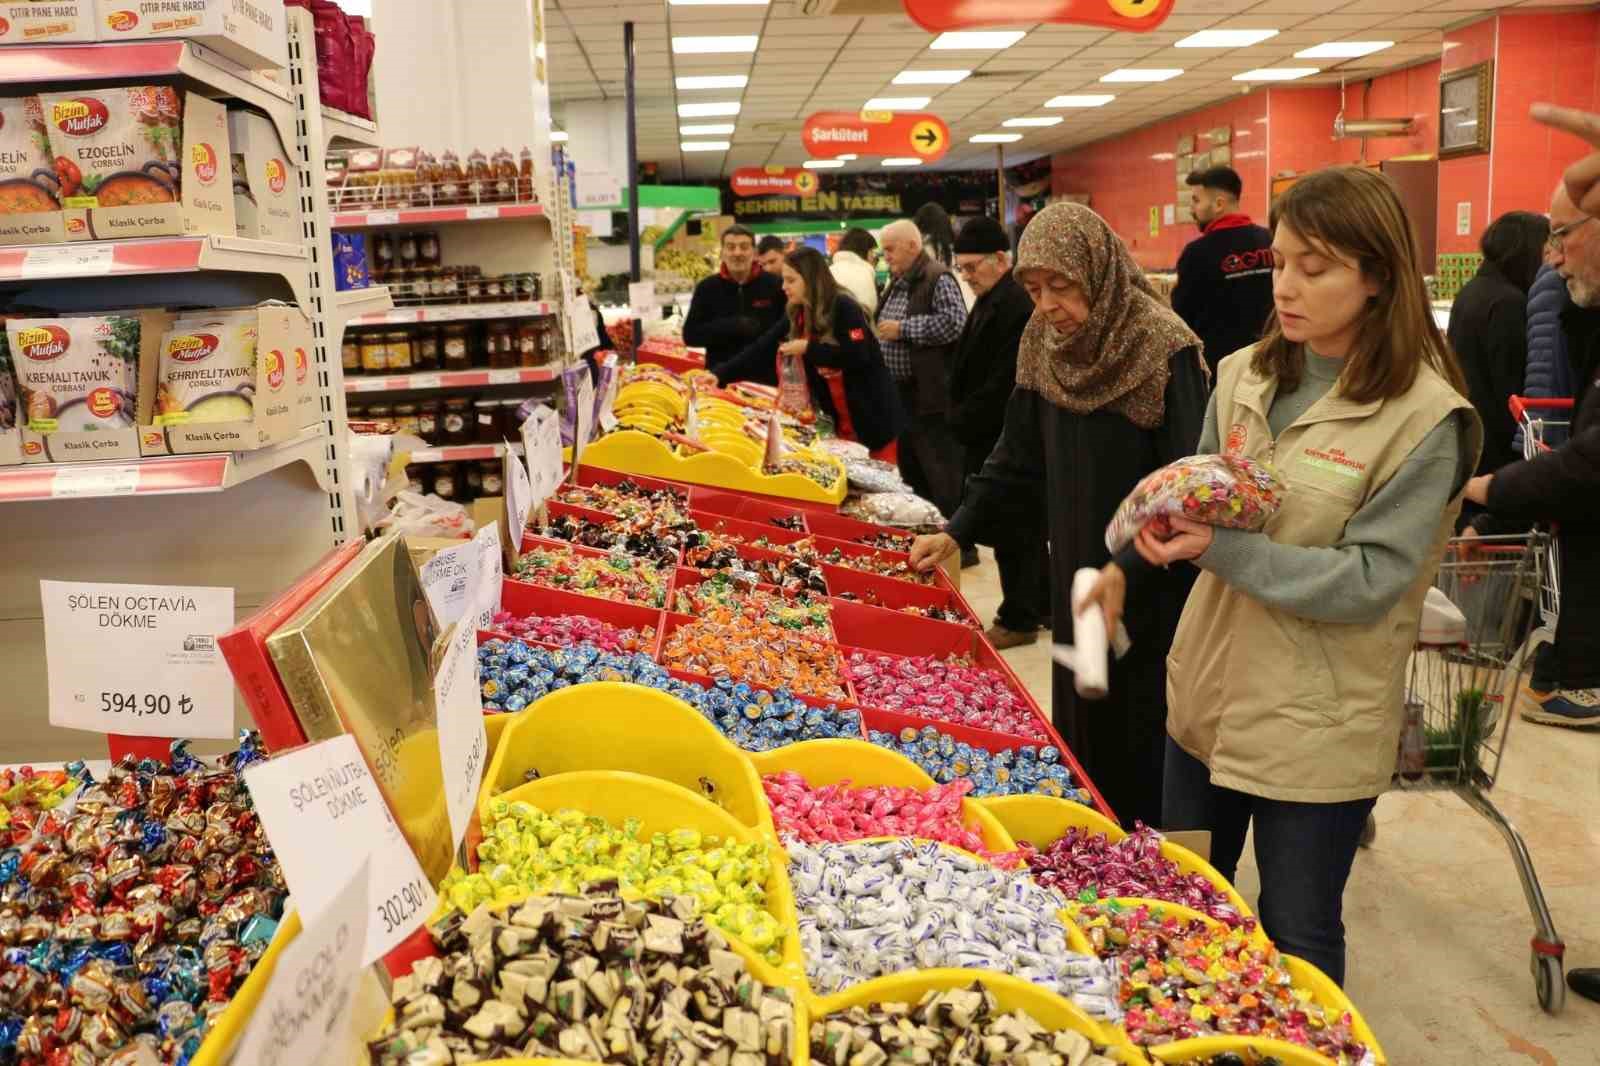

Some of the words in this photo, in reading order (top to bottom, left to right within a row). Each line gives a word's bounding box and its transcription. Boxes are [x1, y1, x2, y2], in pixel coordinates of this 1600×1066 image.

[32, 7, 52, 17] PANE
[54, 6, 78, 17] HARCI
[161, 1, 181, 12] PANE
[53, 103, 85, 121] Bizim
[67, 113, 103, 131] Mutfak
[811, 127, 868, 143] Şarküteri
[78, 143, 135, 160] EZOGELİN
[92, 159, 125, 169] ÇORBASI
[801, 191, 838, 211] EN
[109, 218, 136, 228] Klasik
[18, 331, 48, 346] Bizim
[30, 341, 64, 357] Mutfak
[26, 373, 71, 383] KREMALI
[72, 371, 111, 382] TAVUK
[218, 367, 251, 379] TAVUK
[185, 432, 212, 442] Klasik
[213, 431, 240, 442] Çorba
[64, 441, 91, 450] Klasik
[92, 439, 120, 449] Çorba
[68, 594, 119, 612] ŞÖLEN
[125, 595, 197, 612] OCTAVİA
[98, 611, 157, 628] DÖKME
[101, 692, 171, 717] 594,90
